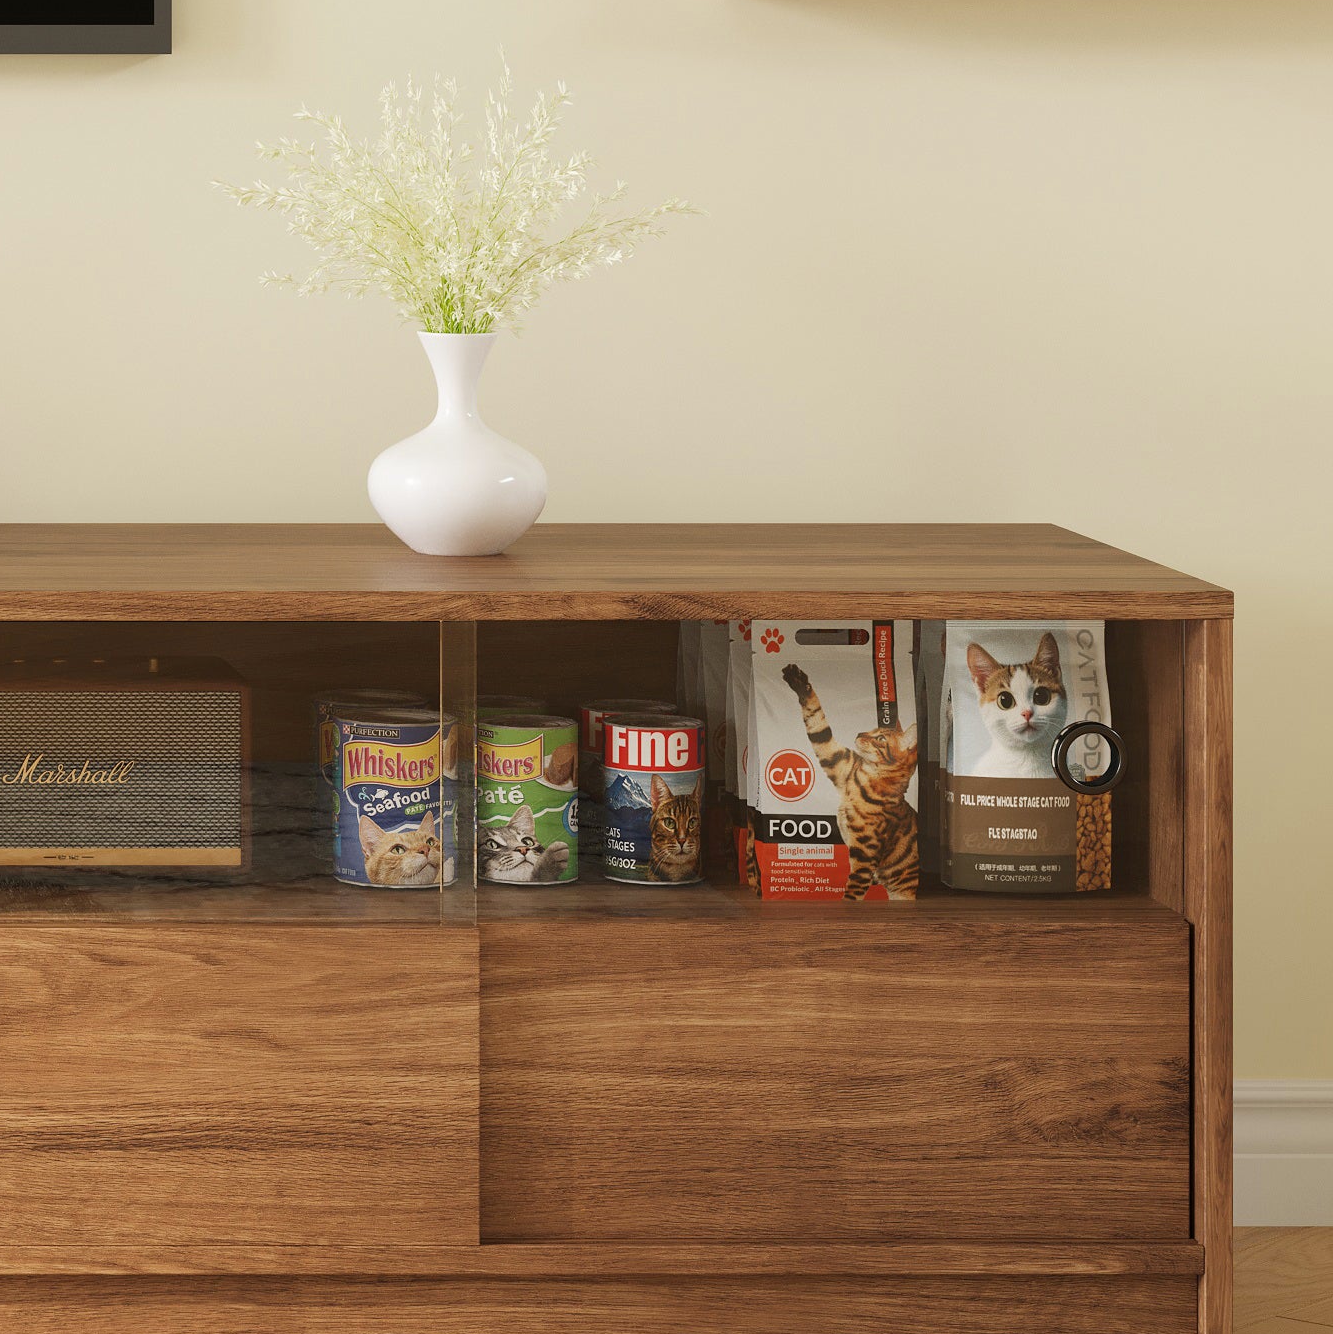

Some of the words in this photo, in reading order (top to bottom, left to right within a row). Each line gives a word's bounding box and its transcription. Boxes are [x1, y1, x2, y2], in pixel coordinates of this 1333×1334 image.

[878, 630, 887, 658] Recipe
[879, 660, 887, 680] Duck
[881, 682, 889, 700] Free
[351, 726, 399, 737] PURFECTION
[2, 753, 134, 784] Marshall
[348, 747, 435, 781] Whiskers
[769, 768, 809, 786] CAT
[363, 788, 431, 817] Seafood
[960, 794, 976, 805] FULL
[977, 795, 995, 806] PRICE
[996, 796, 1017, 808] WHOLE
[1019, 796, 1040, 808] STAGE
[1041, 797, 1053, 808] CAT
[1054, 796, 1070, 808] FOOD
[769, 819, 832, 839] FOOD
[607, 838, 635, 853] STAGES
[780, 847, 804, 856] Single
[806, 846, 833, 855] animal
